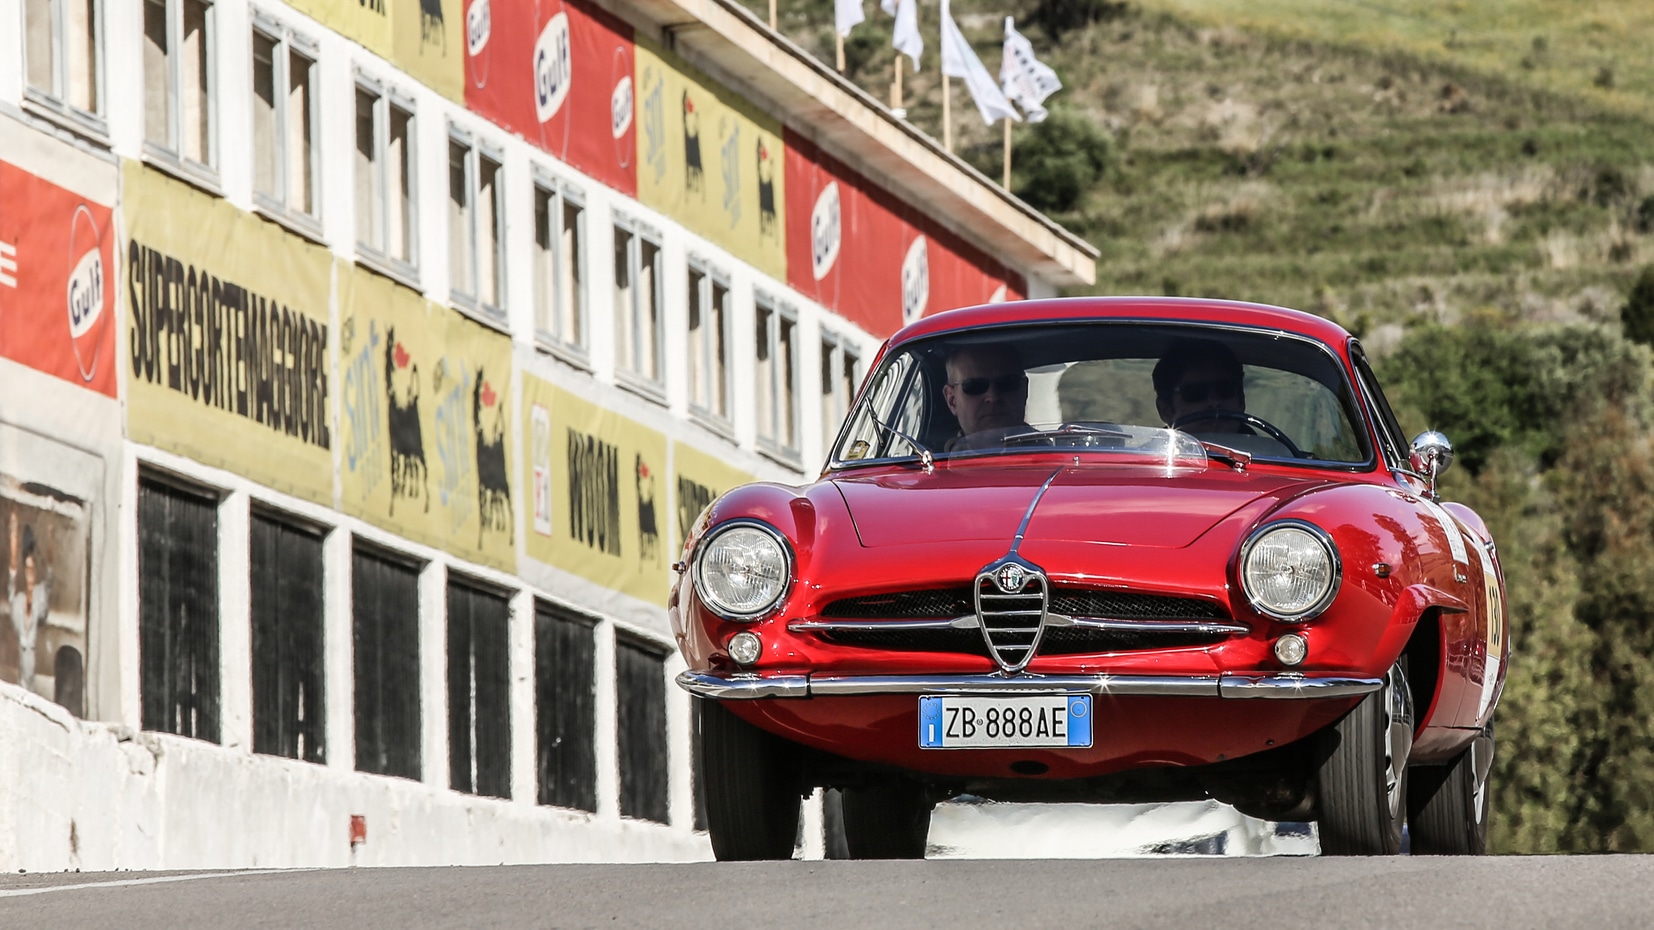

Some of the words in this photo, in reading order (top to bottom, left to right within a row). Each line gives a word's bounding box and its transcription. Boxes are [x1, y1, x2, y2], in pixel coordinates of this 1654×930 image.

[536, 28, 568, 107] Gulf
[70, 259, 101, 326] Gulf
[130, 239, 330, 450] SUPERCORTEMAGGIORE
